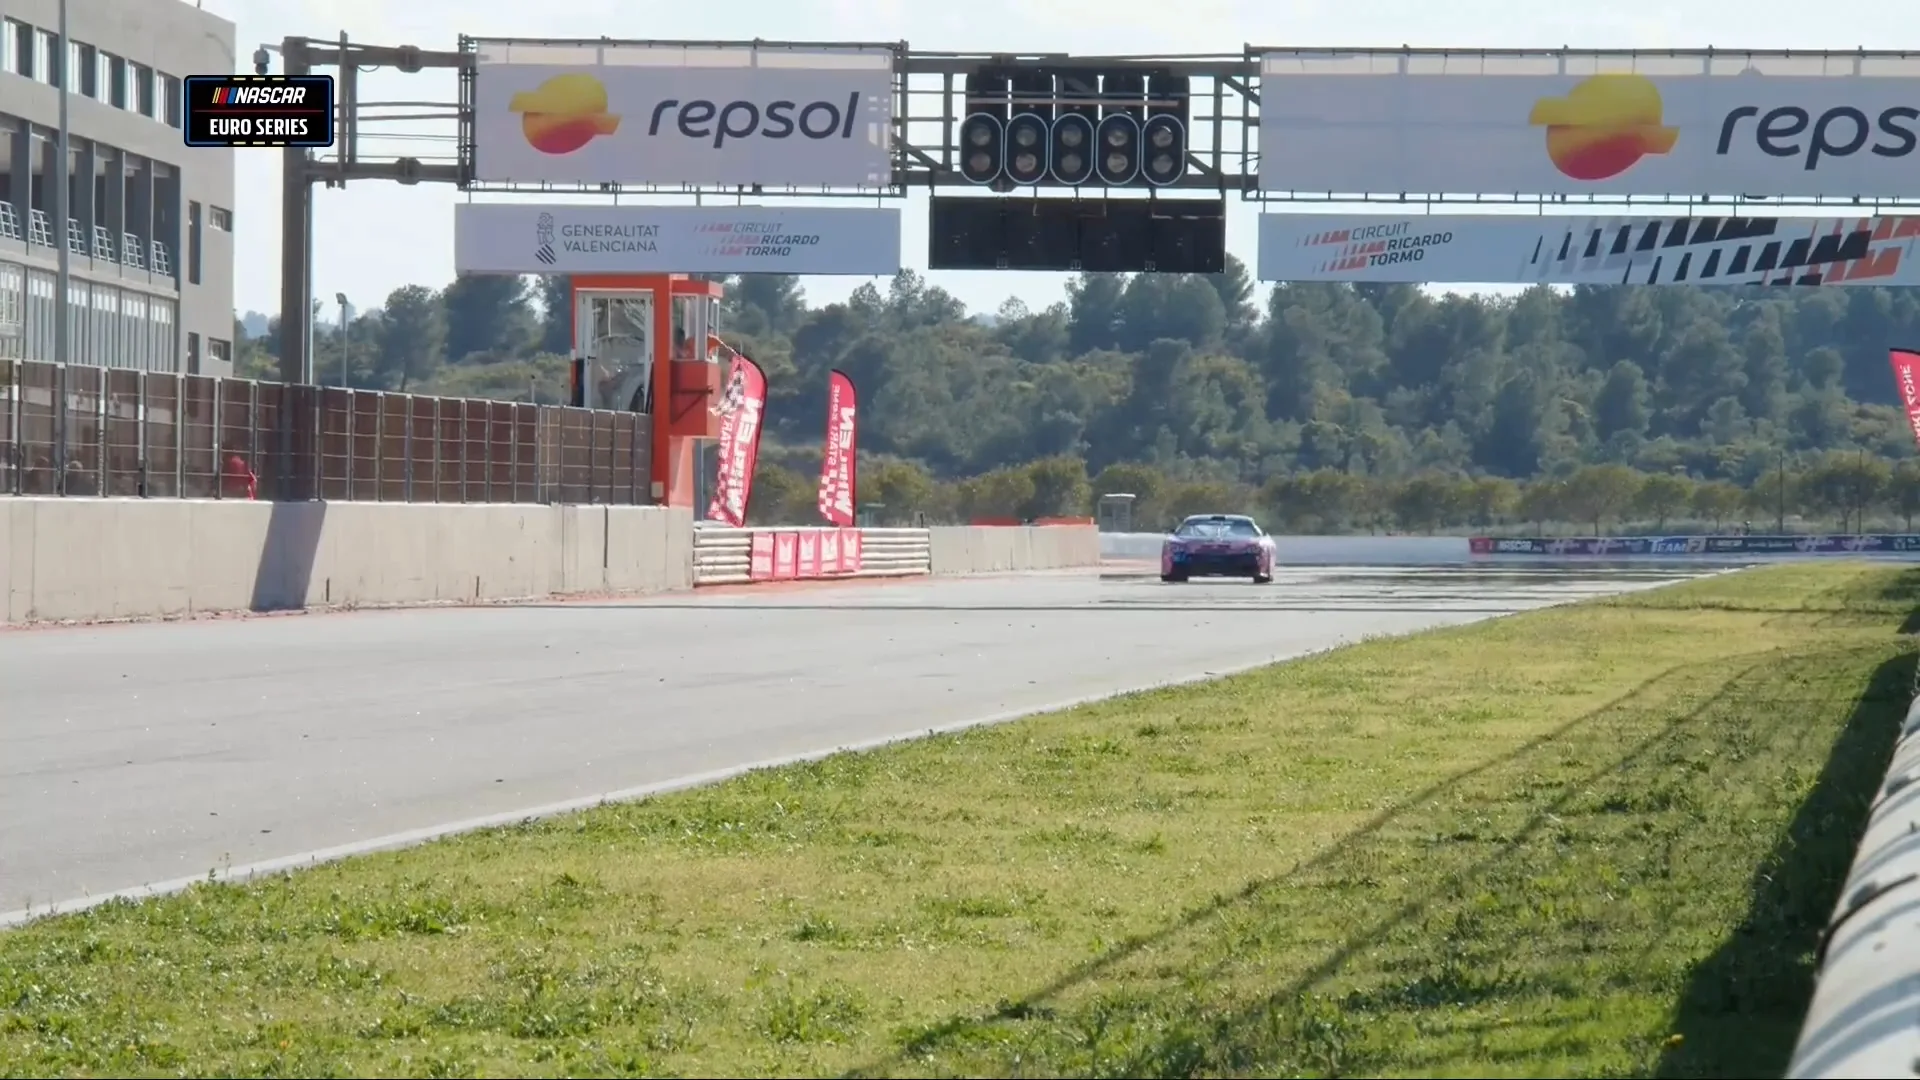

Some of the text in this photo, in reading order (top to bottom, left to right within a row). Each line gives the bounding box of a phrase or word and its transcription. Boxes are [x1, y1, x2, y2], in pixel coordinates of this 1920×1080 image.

[648, 91, 860, 149] repsol
[1716, 105, 1920, 171] reps
[561, 224, 660, 238] GENERALITAT
[733, 222, 783, 233] CIRCUIT
[1351, 221, 1412, 241] CIRCUIT
[563, 239, 658, 253] VALENCIANA
[760, 234, 820, 246] RICARDO
[1387, 231, 1453, 251] RICARDO
[744, 245, 792, 257] TORMO
[1369, 248, 1425, 267] TORMO
